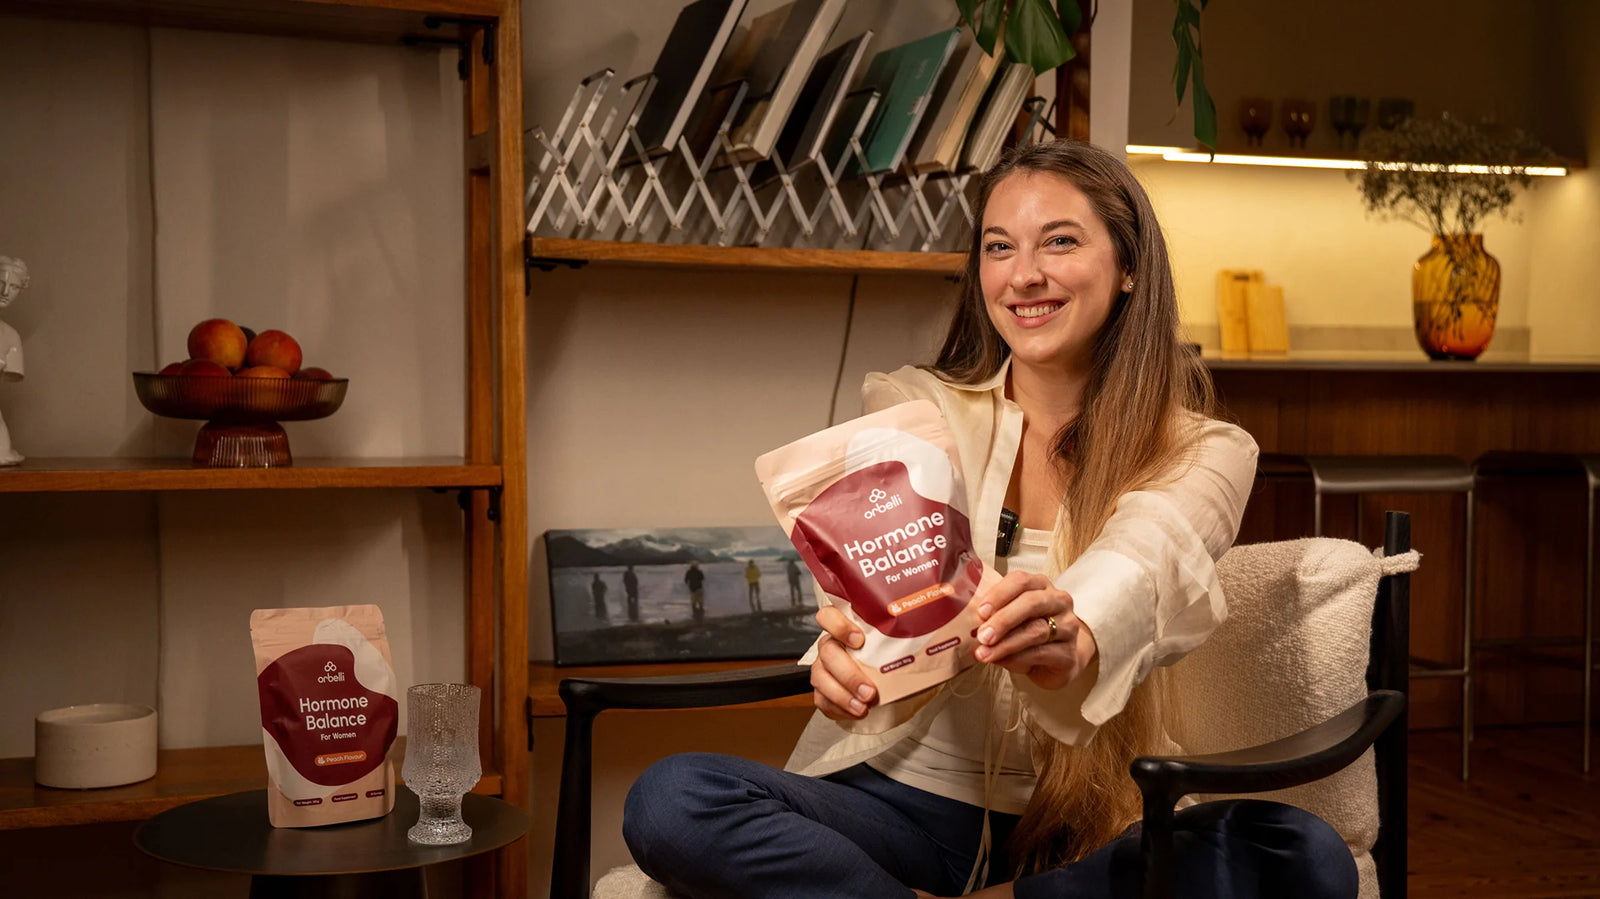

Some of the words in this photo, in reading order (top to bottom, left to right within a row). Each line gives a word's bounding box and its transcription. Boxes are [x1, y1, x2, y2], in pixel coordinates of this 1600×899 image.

[863, 494, 903, 520] orbelli
[843, 511, 945, 560] Hormone
[858, 534, 947, 578] Balance
[885, 573, 901, 585] For
[901, 558, 939, 578] Women
[902, 595, 927, 608] Peach
[317, 672, 345, 684] orbelli
[299, 696, 369, 713] Hormone
[305, 713, 367, 731] Balance
[320, 733, 332, 741] For
[332, 731, 357, 740] Women
[326, 755, 344, 763] Peach
[343, 753, 364, 761] Flavour
